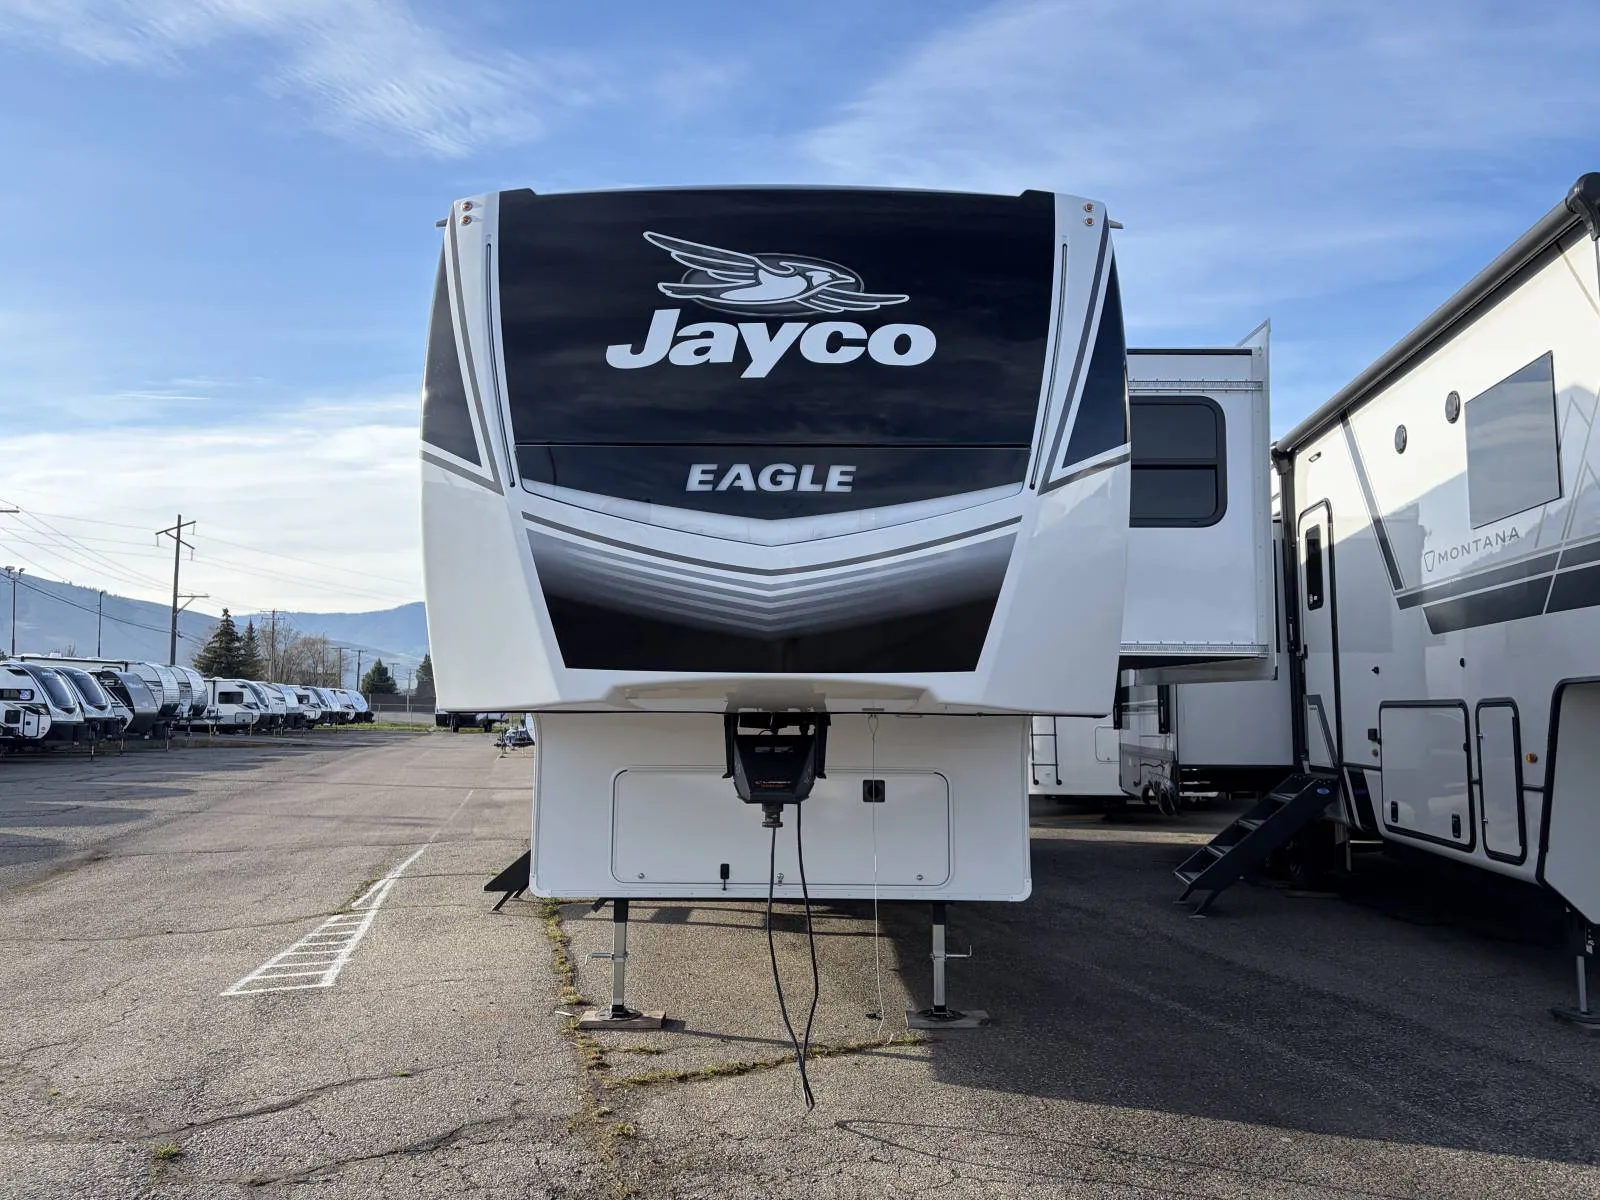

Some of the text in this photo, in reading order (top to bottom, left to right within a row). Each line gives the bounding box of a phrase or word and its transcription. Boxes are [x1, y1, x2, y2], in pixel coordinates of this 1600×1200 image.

[605, 308, 937, 379] Jayco
[686, 463, 857, 493] EAGLE
[1438, 526, 1521, 565] MONTANA
